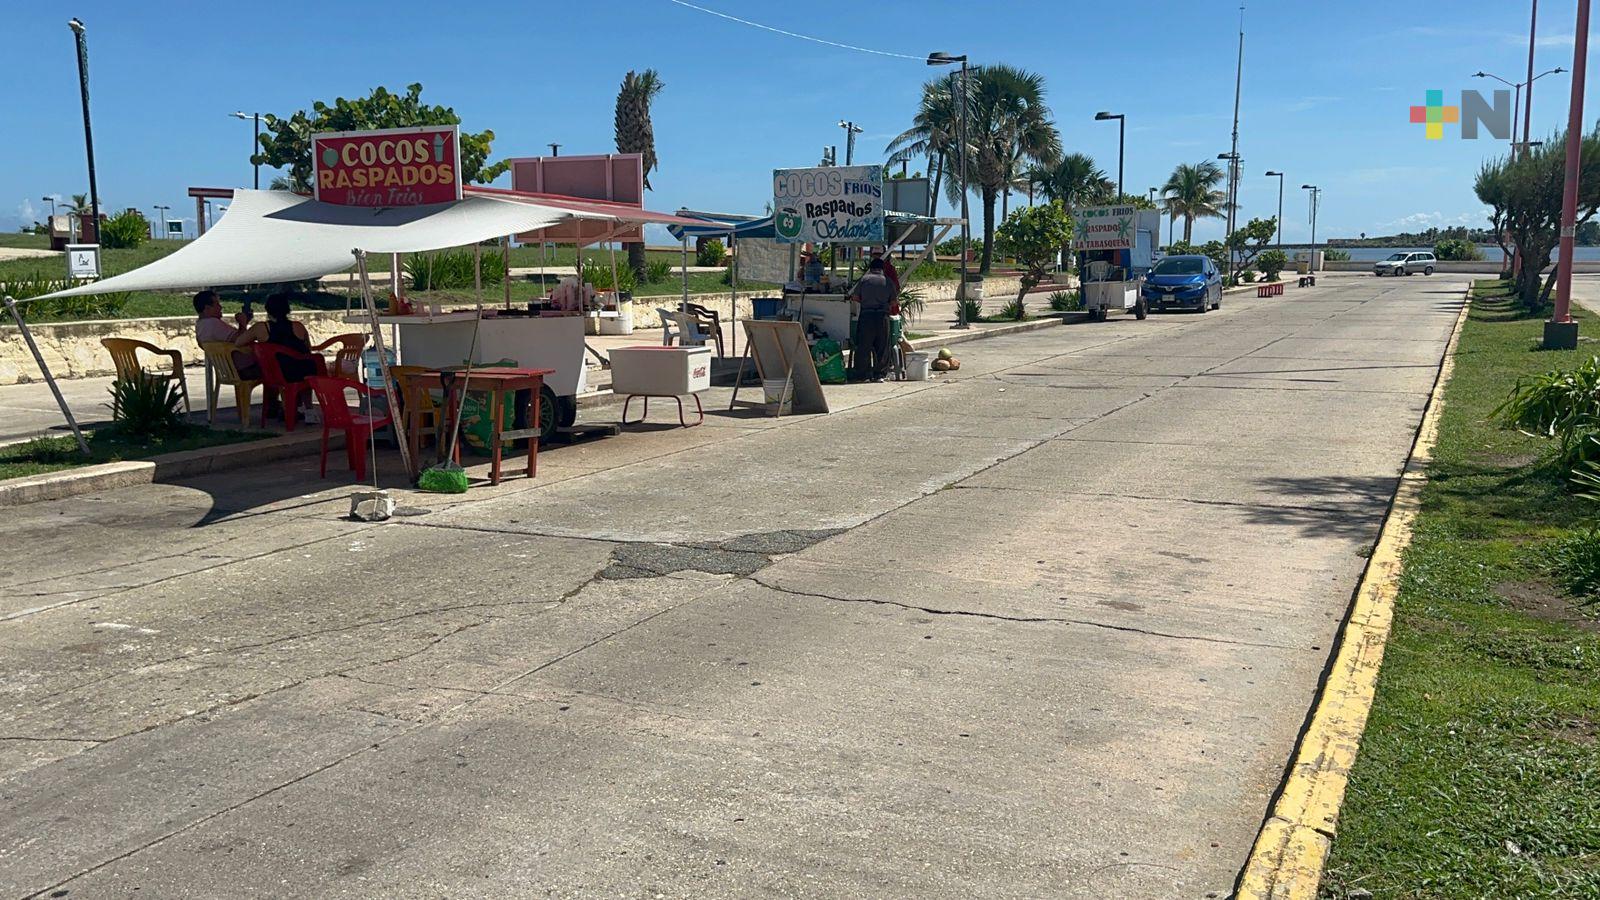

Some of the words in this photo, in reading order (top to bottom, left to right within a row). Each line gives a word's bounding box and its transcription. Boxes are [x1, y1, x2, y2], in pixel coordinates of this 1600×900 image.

[341, 139, 430, 167] COCOS
[320, 164, 454, 190] RASPADOS
[774, 171, 842, 198] COCOS
[805, 199, 872, 218] Raspados
[1082, 208, 1109, 218] COCOS
